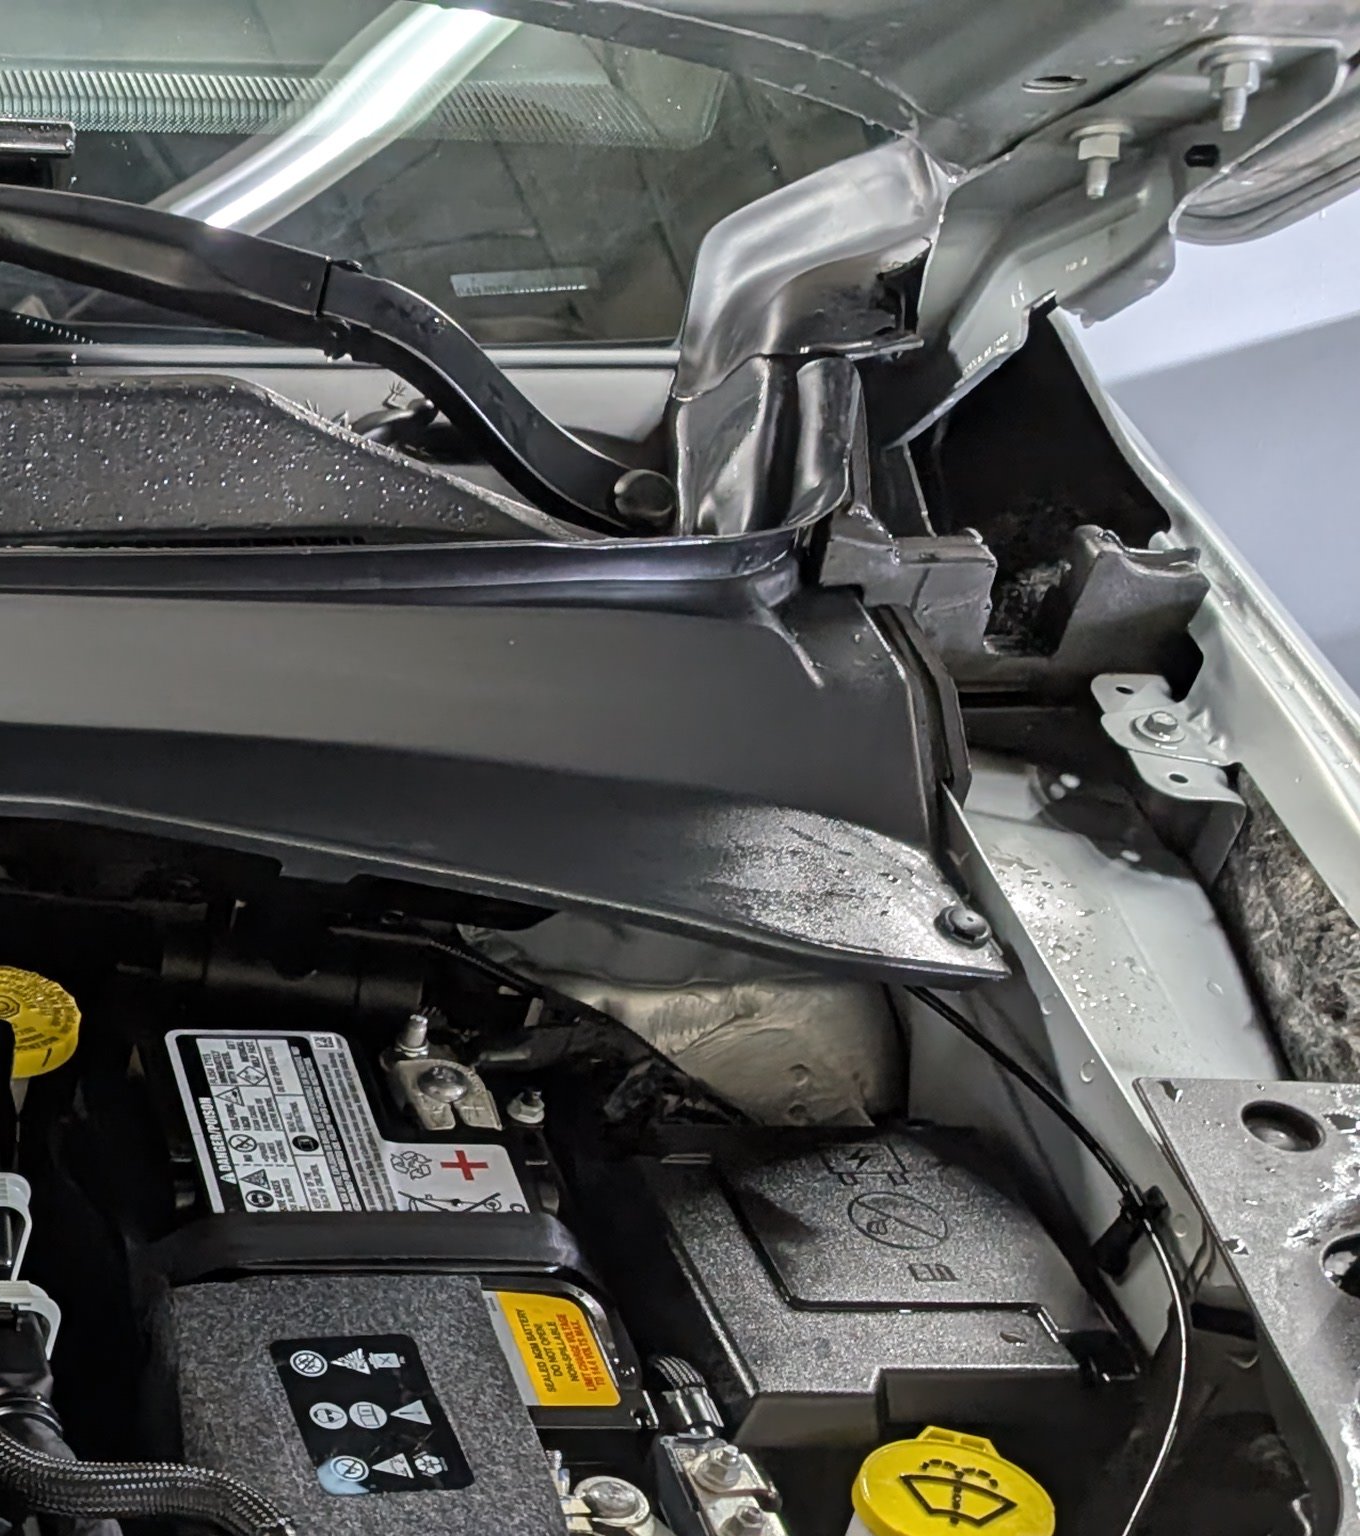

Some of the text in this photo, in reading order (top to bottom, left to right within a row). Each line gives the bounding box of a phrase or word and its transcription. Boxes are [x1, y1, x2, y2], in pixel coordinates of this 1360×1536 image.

[198, 1097, 232, 1172] DANGER/POISON
[516, 1307, 557, 1392] SEALED AGM BATTERY
[543, 1347, 559, 1363] NOT
[550, 1364, 563, 1377] DO
